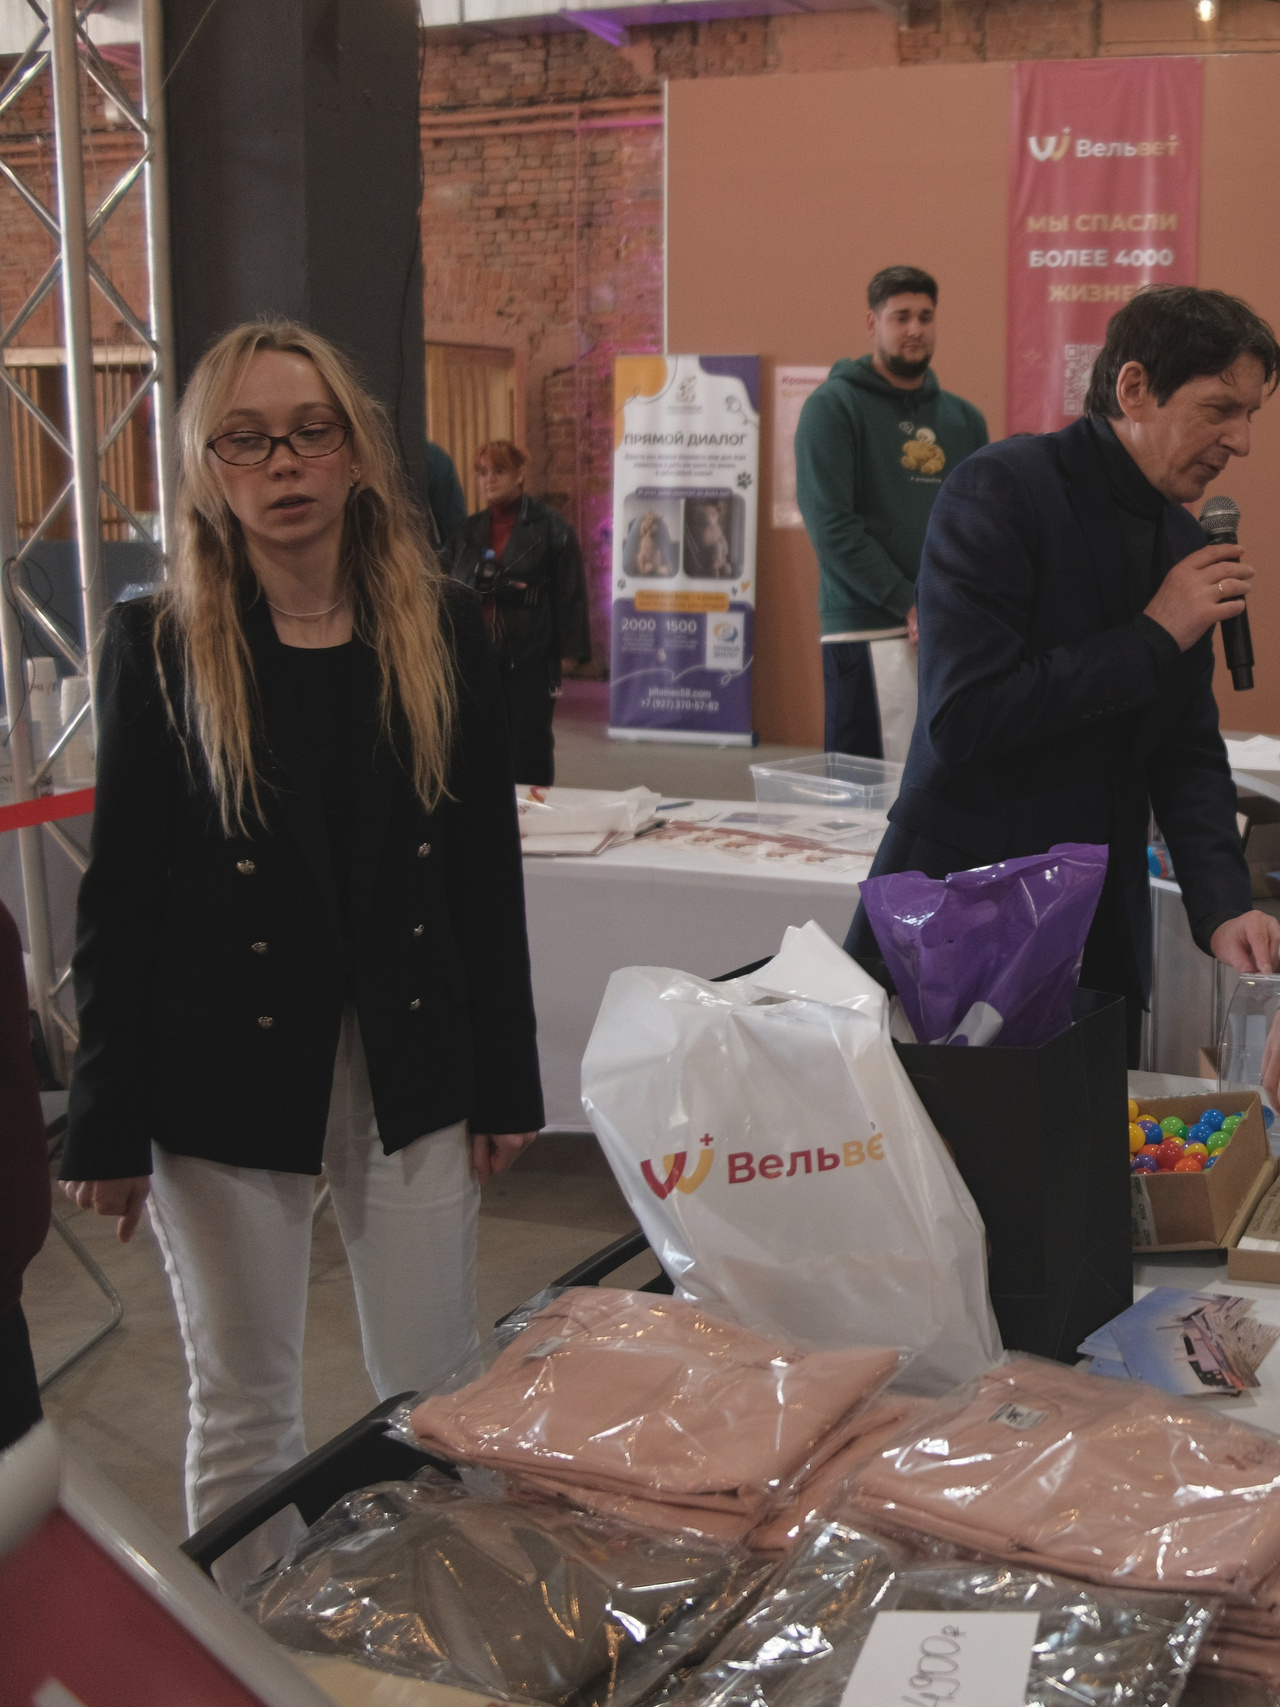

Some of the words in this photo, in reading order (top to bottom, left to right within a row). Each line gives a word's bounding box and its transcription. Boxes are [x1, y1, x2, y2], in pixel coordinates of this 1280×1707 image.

[1075, 135, 1179, 159] Вельвет
[1027, 214, 1068, 233] МЫ
[1075, 213, 1177, 233] СПАСЛИ
[1029, 249, 1108, 267] БОЛЕЕ
[1115, 248, 1174, 267] 4000
[1049, 283, 1143, 302] ЖИЗНЕ
[624, 431, 684, 446] ПРЯМОЙ
[687, 433, 748, 447] ДИАЛОГ
[621, 617, 657, 631] 2000
[665, 619, 698, 633] 1500
[727, 1131, 885, 1185] Вельве
